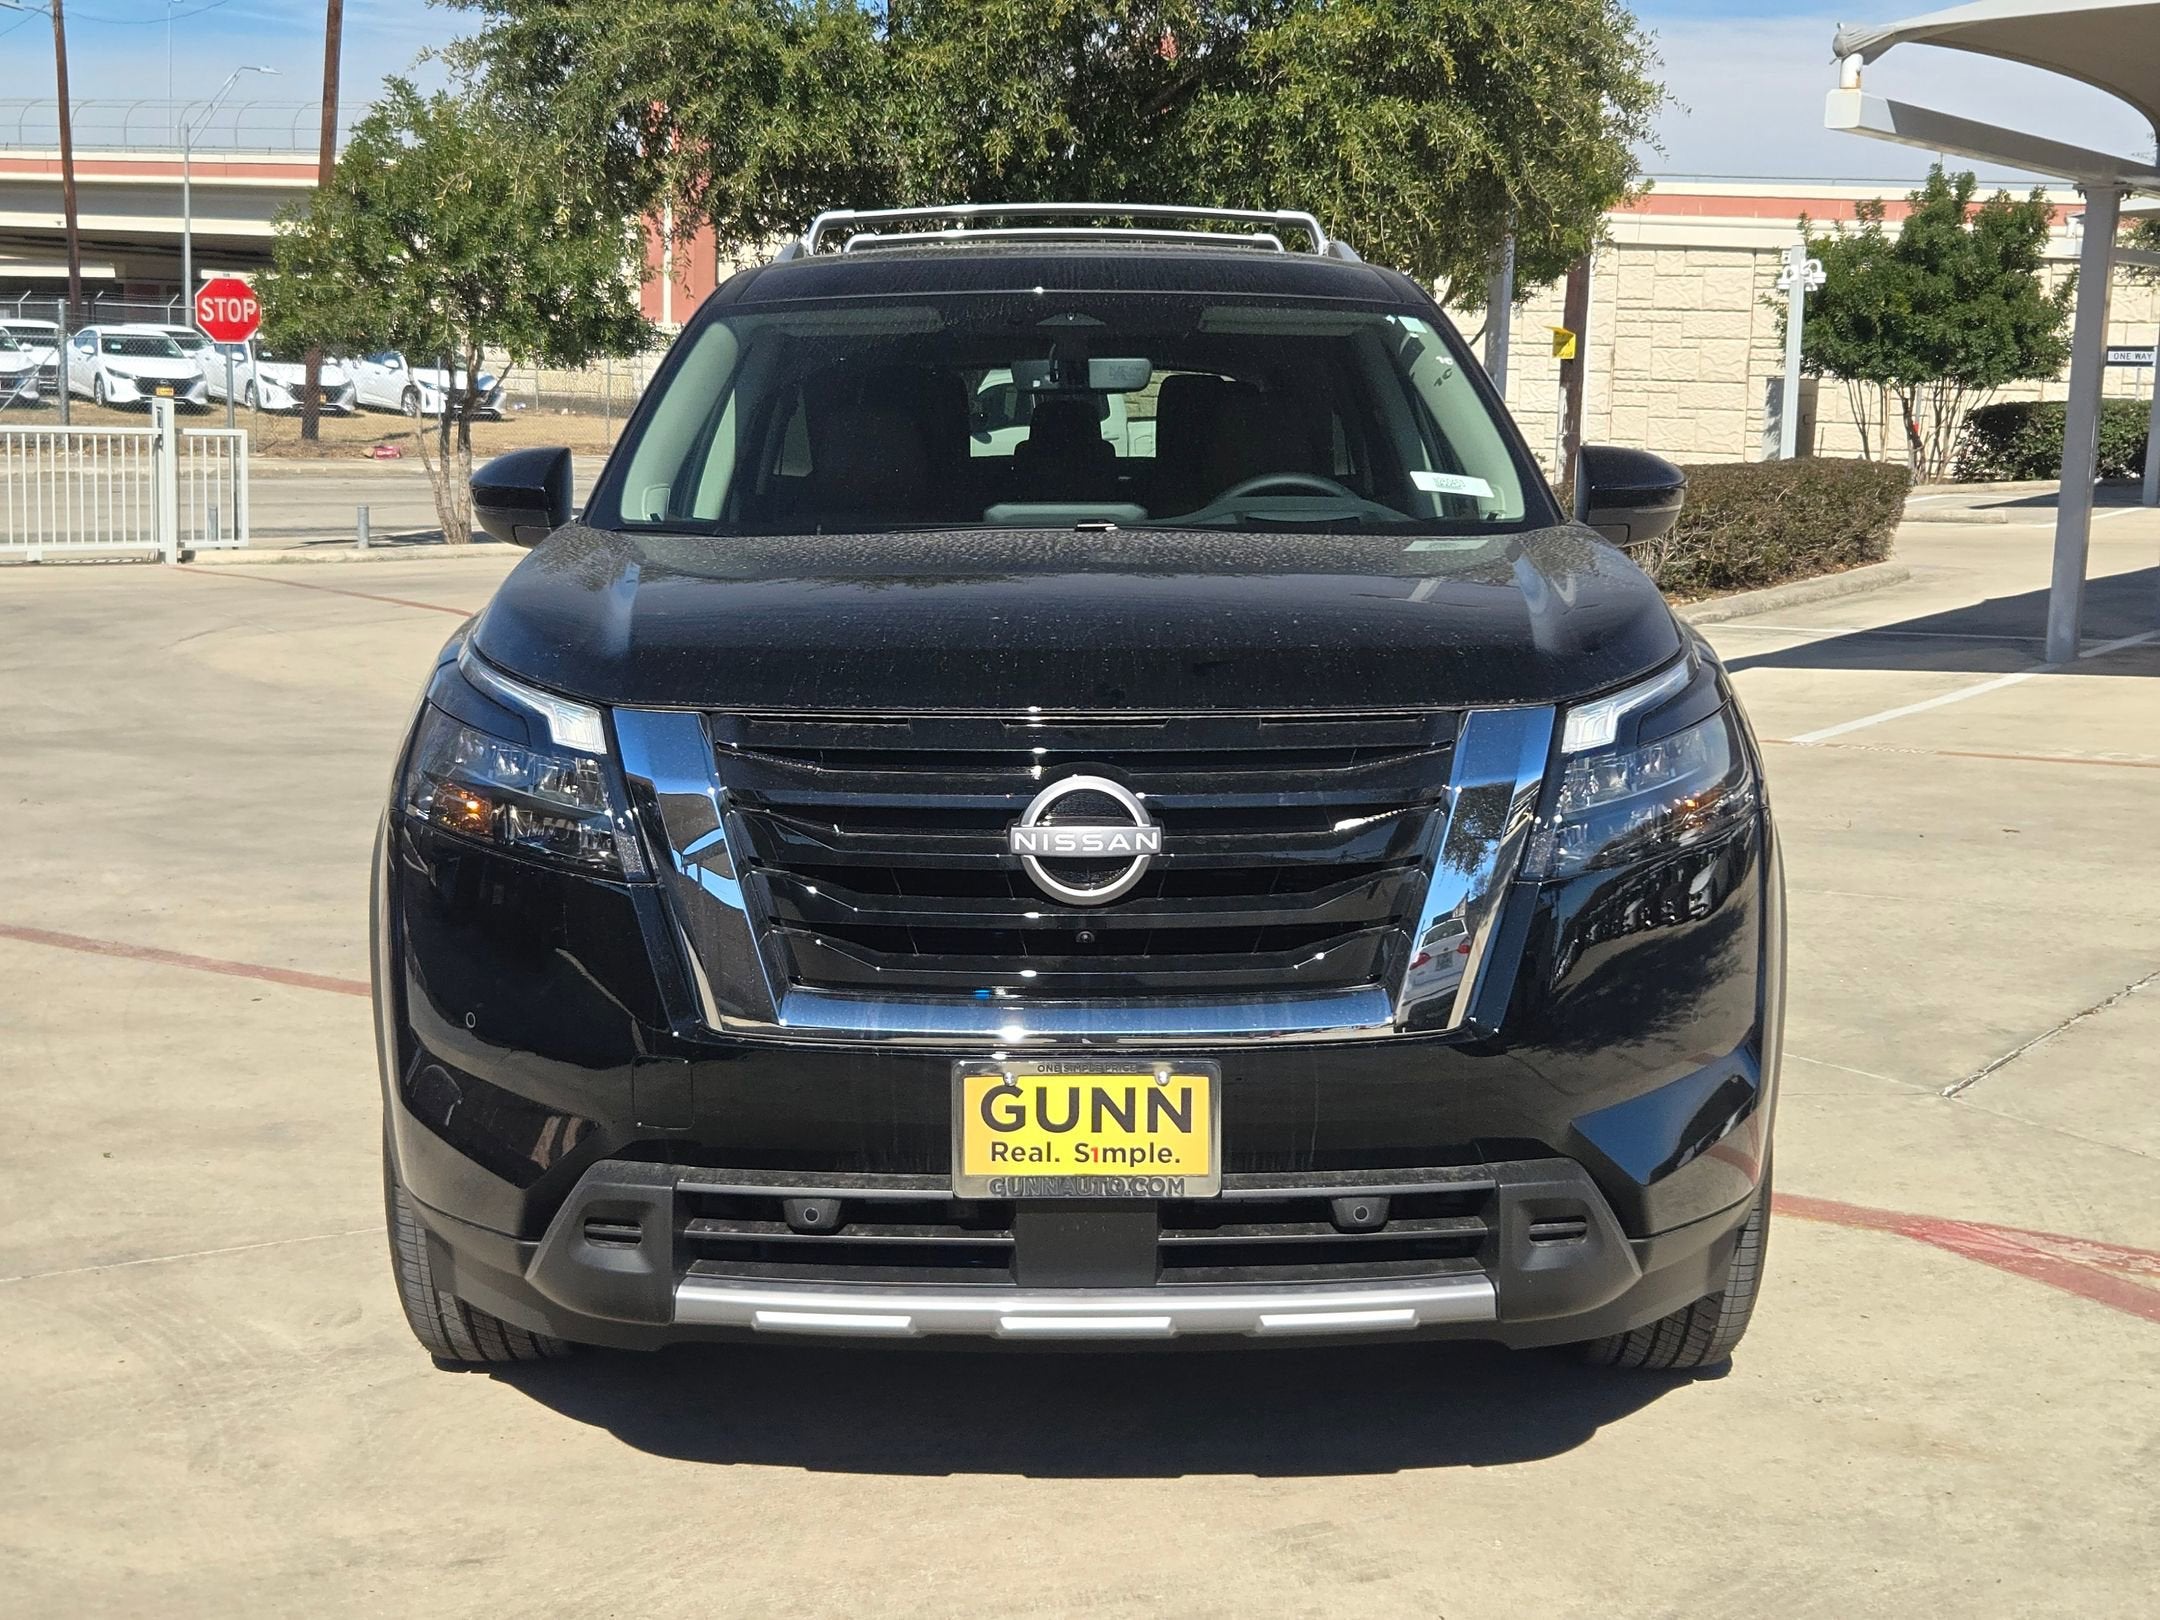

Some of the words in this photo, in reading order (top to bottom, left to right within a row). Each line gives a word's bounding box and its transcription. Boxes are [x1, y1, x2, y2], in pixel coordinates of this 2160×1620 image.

[200, 297, 257, 323] STOP
[2113, 352, 2131, 361] ONE
[2134, 352, 2153, 361] WAY
[1014, 832, 1158, 851] NISSAN
[1037, 1063, 1061, 1073] ONE
[1063, 1063, 1102, 1073] SIMPLE
[1105, 1063, 1137, 1073] PRICE
[980, 1084, 1192, 1134] GUNN
[991, 1141, 1060, 1163] Real.
[989, 1176, 1186, 1197] GUNNAUTO.COM
